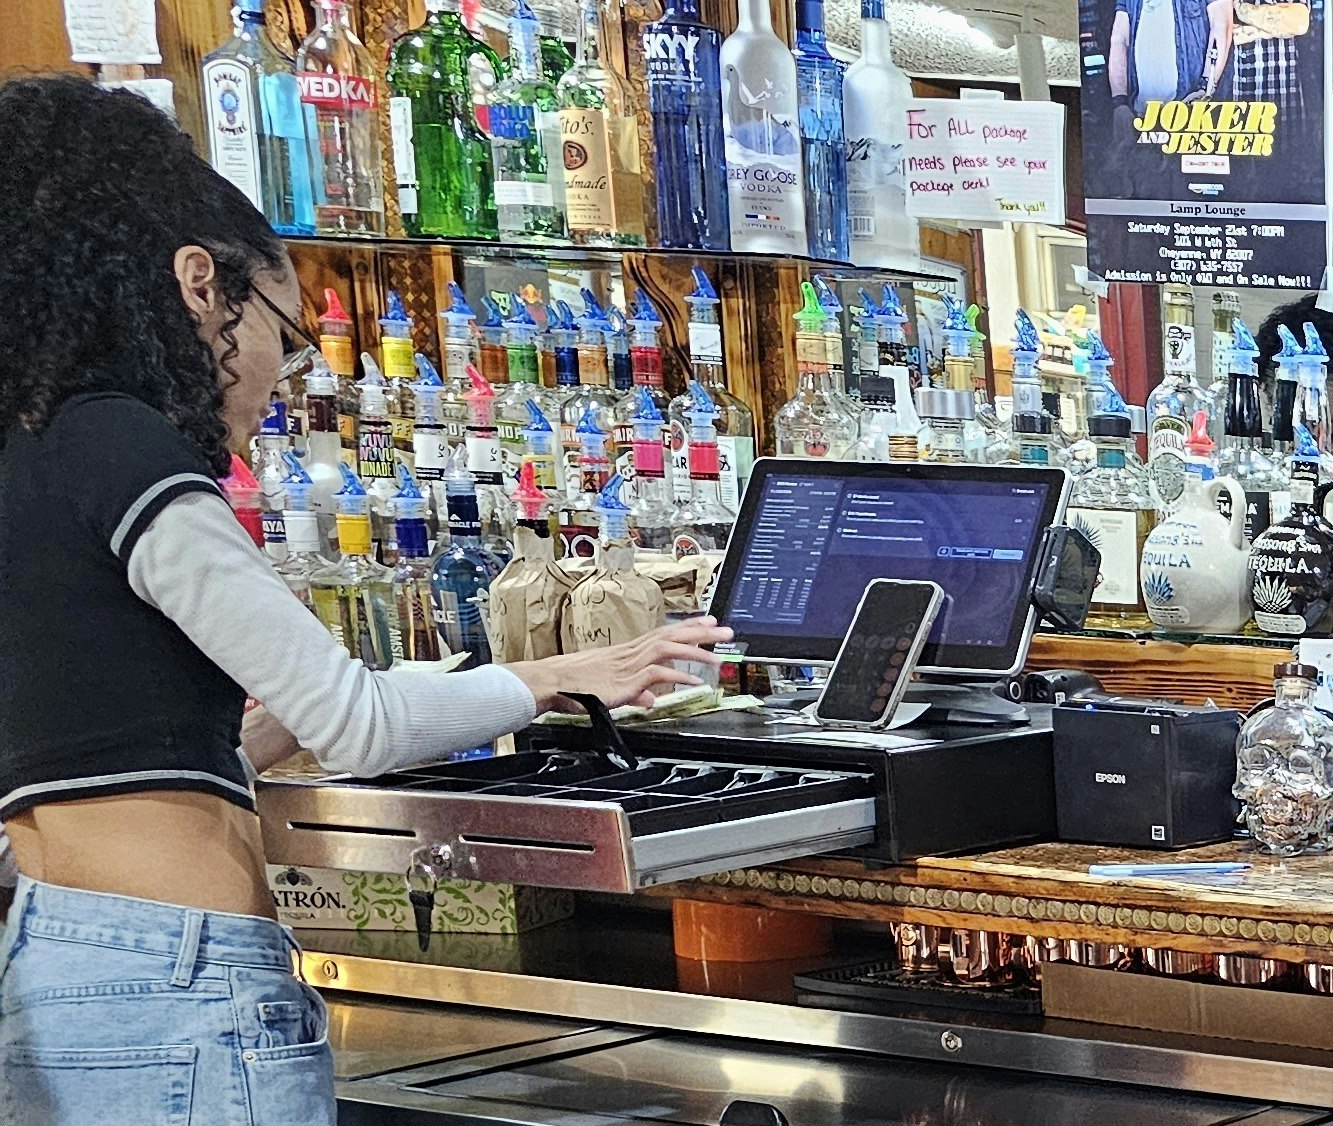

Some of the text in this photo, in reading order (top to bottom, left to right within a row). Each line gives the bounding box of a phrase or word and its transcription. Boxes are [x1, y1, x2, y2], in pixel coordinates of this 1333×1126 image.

[643, 32, 699, 62] SKYY
[298, 76, 371, 104] VEDKA
[1132, 100, 1278, 134] JOKER
[906, 108, 1028, 144] For ALL package
[1136, 131, 1171, 144] AND
[1161, 132, 1274, 157] JESTER
[908, 155, 1049, 175] needs please see your
[753, 168, 798, 186] GOOSE
[740, 182, 783, 194] VODKA
[910, 180, 954, 196] package
[1170, 203, 1246, 217] Lamp Lounge
[1127, 221, 1171, 236] Saturday
[1173, 222, 1222, 237] September
[1225, 224, 1247, 237] 21st
[1226, 237, 1238, 248] St
[1209, 248, 1222, 260] WY
[1104, 269, 1153, 282] Admission
[1155, 270, 1167, 282] is
[1169, 270, 1193, 285] Only
[1215, 273, 1234, 285] and
[1236, 273, 1249, 285] On
[1251, 274, 1276, 287] Sale
[1144, 552, 1192, 569] QUILA
[1095, 772, 1127, 785] EPSON
